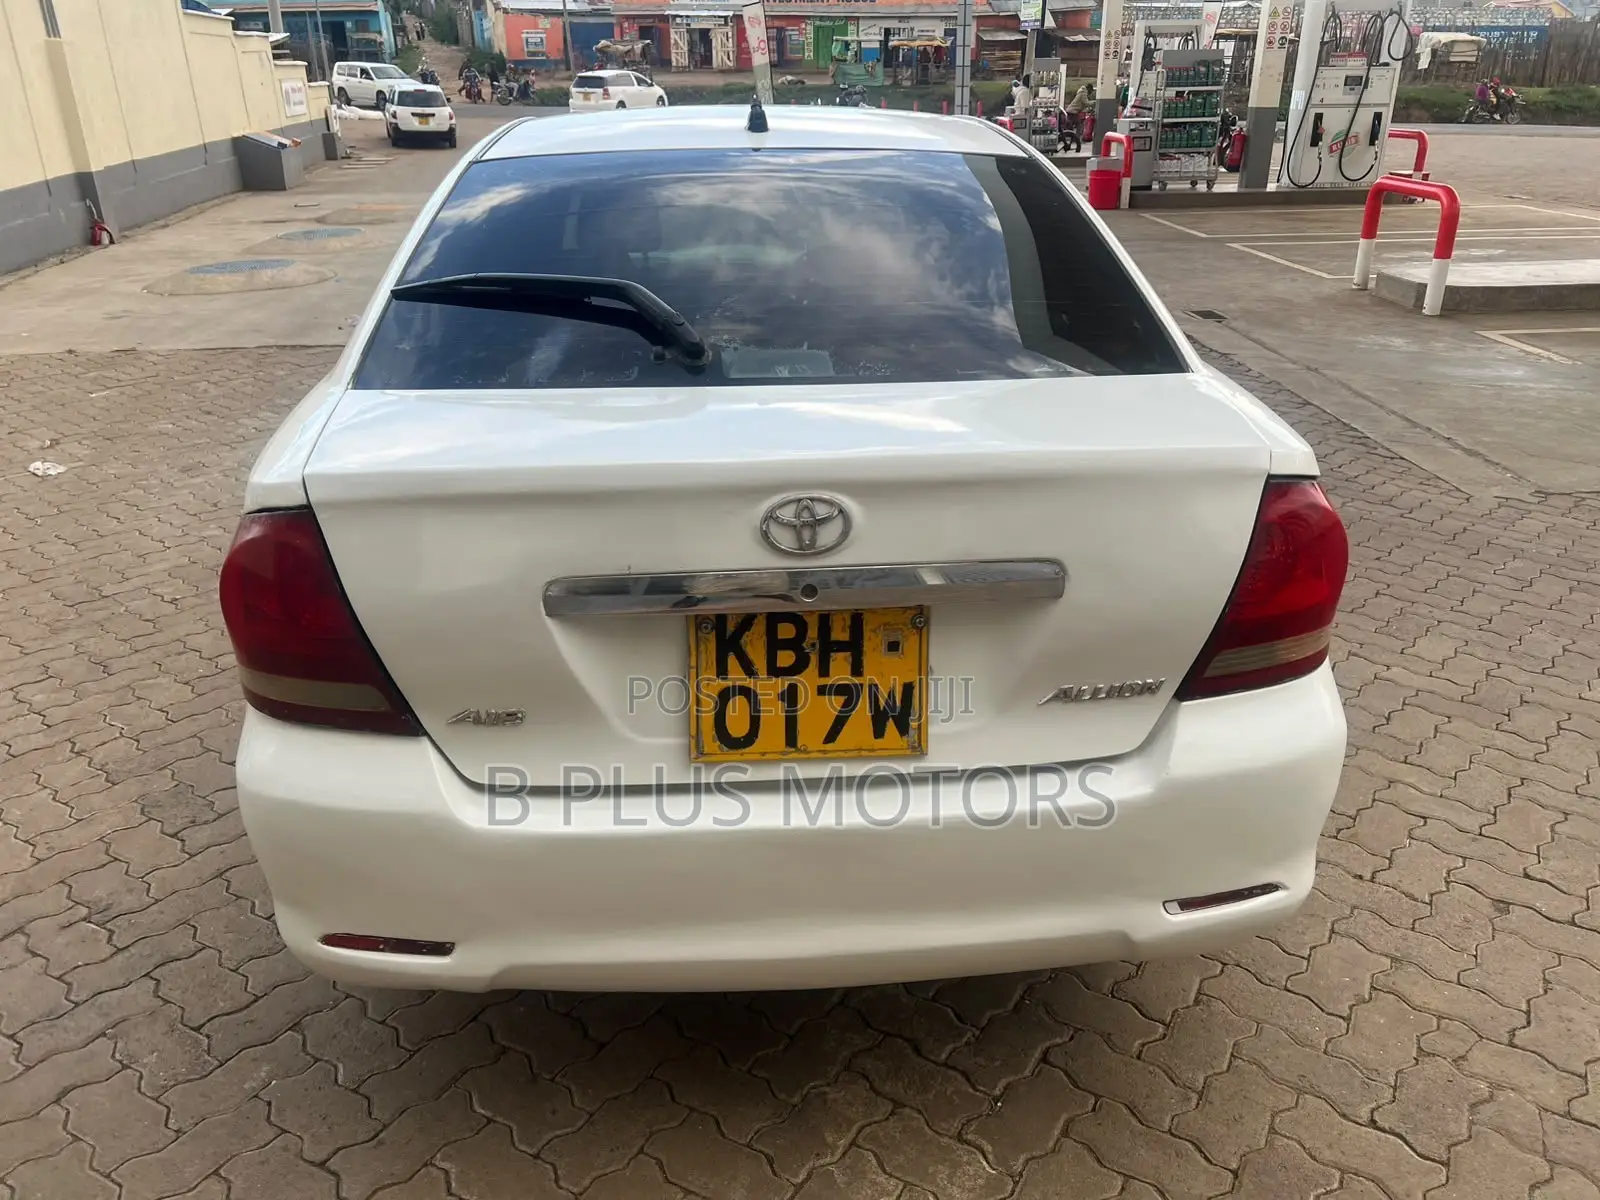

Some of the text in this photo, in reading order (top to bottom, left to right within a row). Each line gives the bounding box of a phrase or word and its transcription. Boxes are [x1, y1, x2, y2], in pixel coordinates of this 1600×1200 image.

[714, 611, 865, 682] KBH
[713, 682, 916, 750] 017W
[1038, 677, 1166, 705] ALLION
